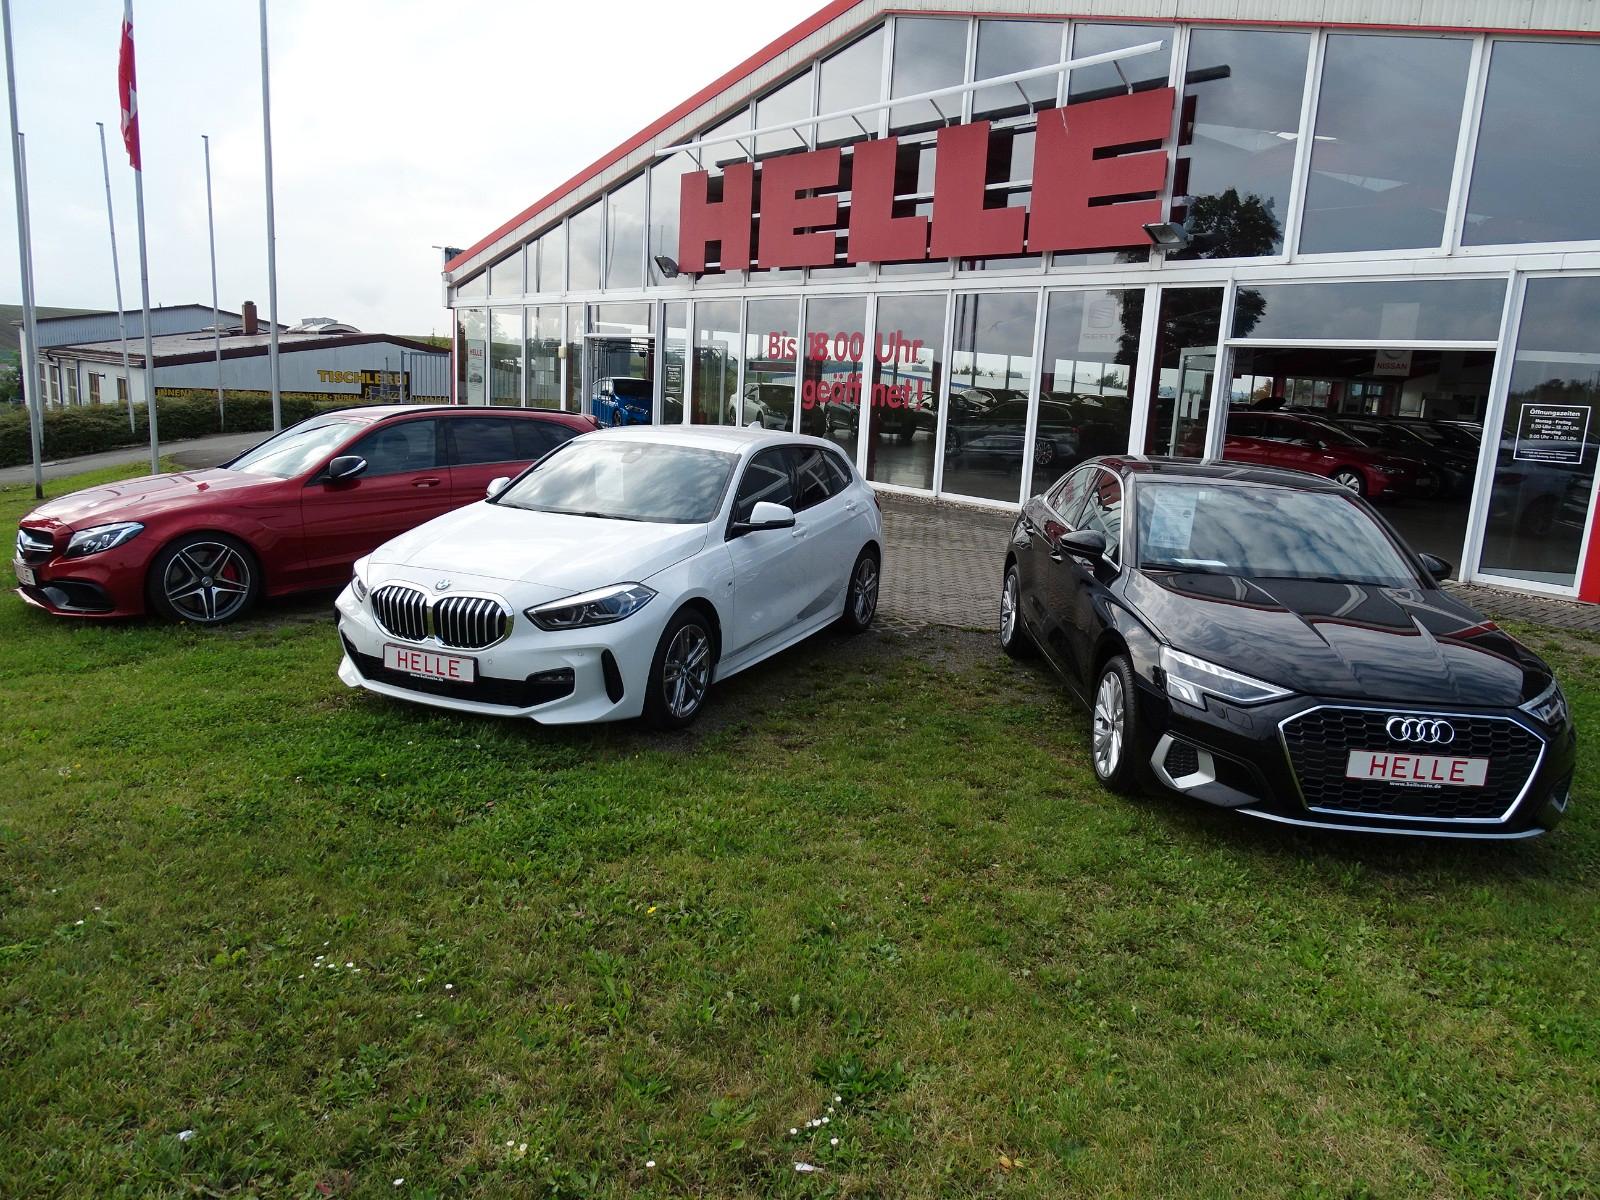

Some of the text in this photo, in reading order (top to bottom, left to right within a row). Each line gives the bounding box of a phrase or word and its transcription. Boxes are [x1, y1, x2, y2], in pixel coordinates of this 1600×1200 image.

[679, 87, 1175, 273] HELLE
[767, 329, 924, 363] Bis 18.00 Uhr
[317, 369, 408, 385] TISCHLEREI
[1376, 361, 1408, 369] NISSAN
[1529, 408, 1580, 417] Öffnungszeiten
[398, 651, 460, 677] HELLE
[1369, 756, 1468, 782] HELLE
